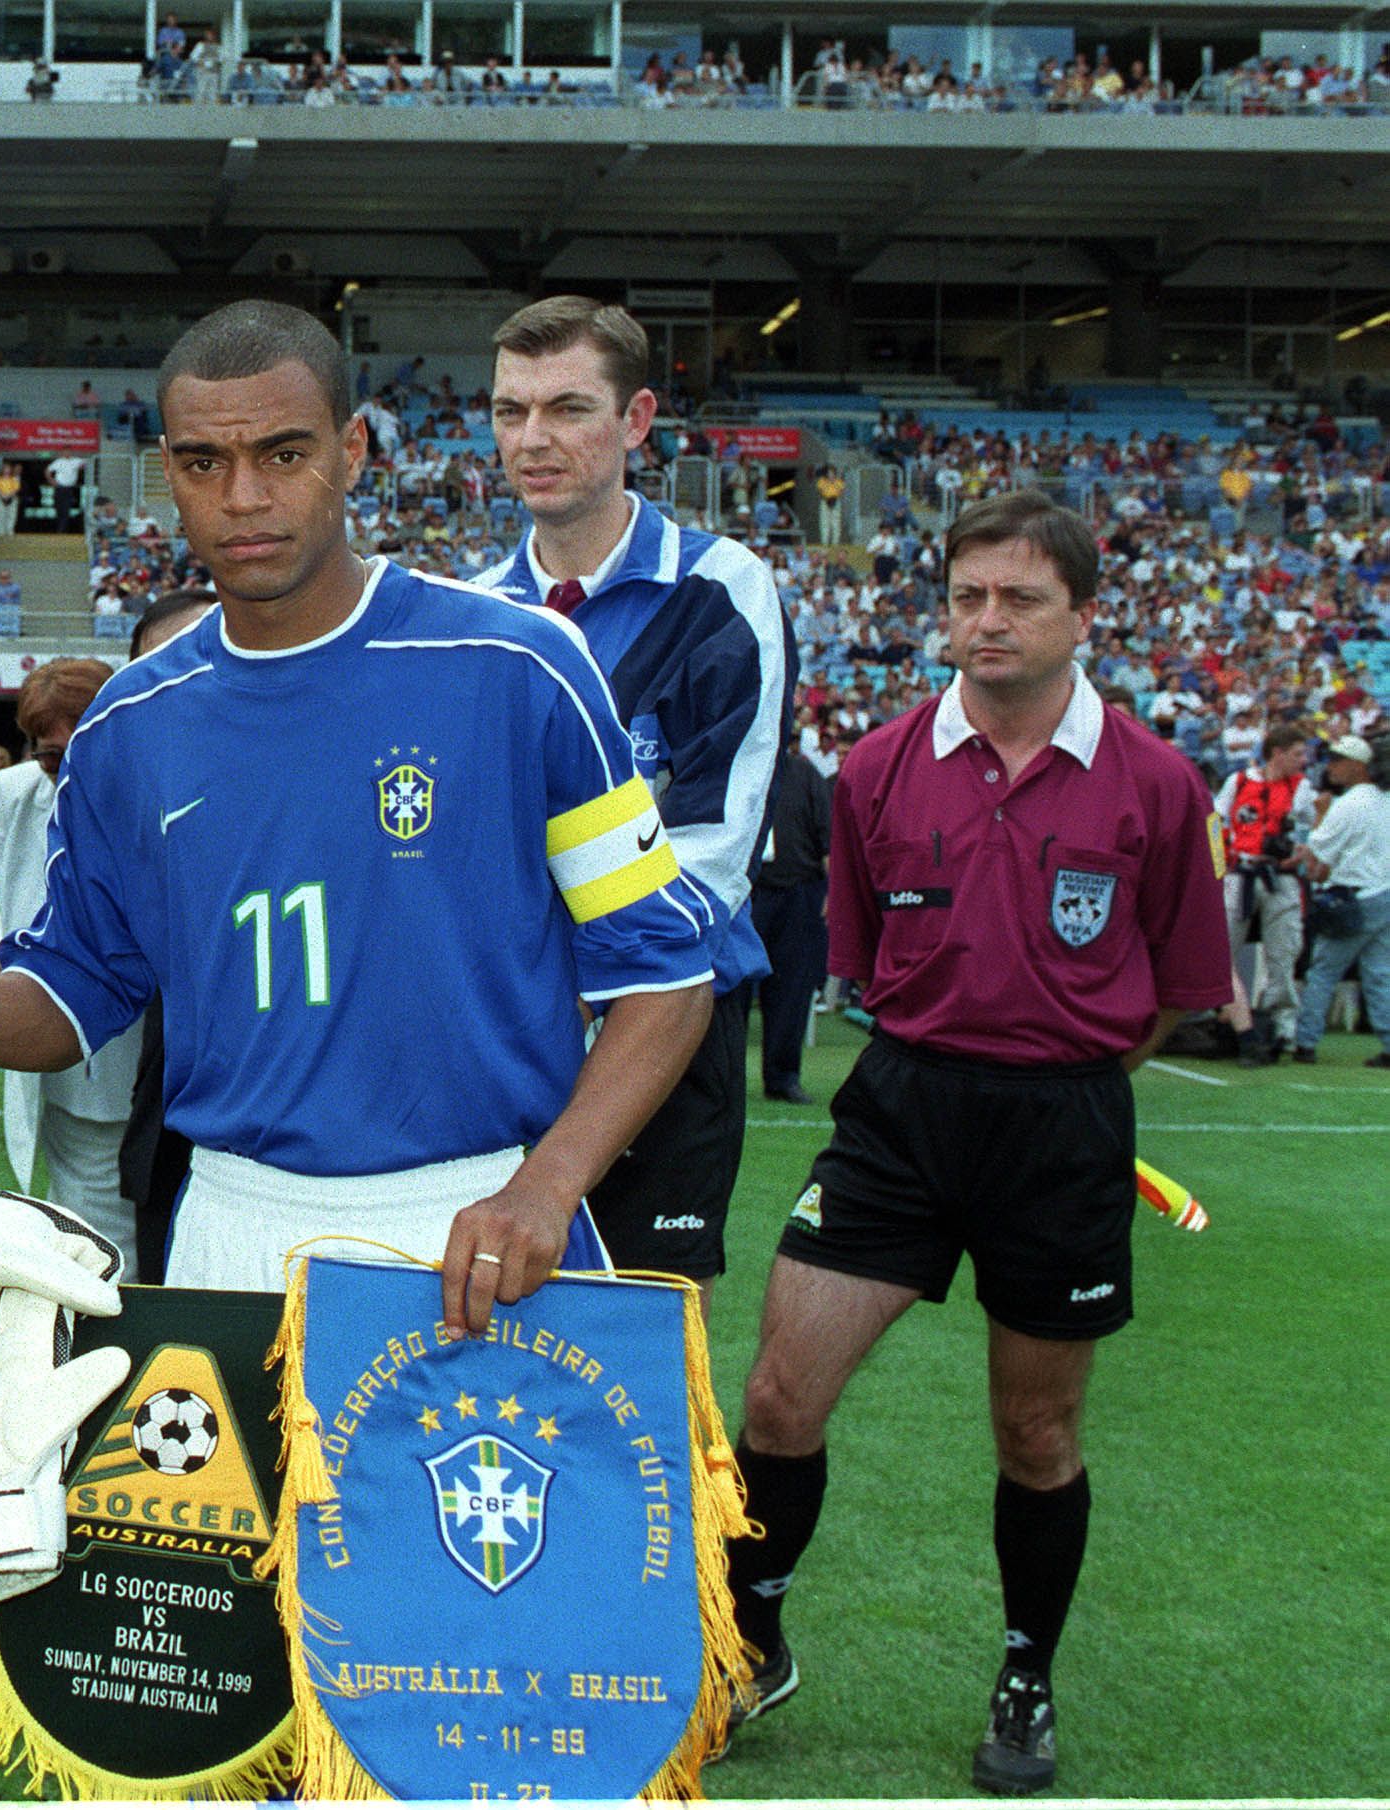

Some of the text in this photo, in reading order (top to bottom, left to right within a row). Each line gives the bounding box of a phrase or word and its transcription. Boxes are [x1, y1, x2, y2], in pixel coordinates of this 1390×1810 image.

[395, 795, 417, 806] CBF
[232, 881, 330, 1012] 11
[1063, 923, 1092, 937] FIFA
[653, 1214, 705, 1230] lotto
[317, 1318, 672, 1584] CONEDERAÇÃO BSILEIRA DE FUTEBOL
[77, 1487, 257, 1534] SOCCER
[469, 1496, 515, 1513] CBF
[71, 1523, 254, 1559] AUSTRALIA
[80, 1571, 234, 1612] LG SOCCEROOS
[142, 1605, 167, 1628] VS
[115, 1626, 187, 1657] BRAZIL
[44, 1648, 253, 1693] SUNDAY, NOVEMBER 14, 1999
[337, 1660, 667, 1702] AUSTRÁLIA X BRASIL
[71, 1676, 219, 1715] STADIUM AUSTRALIA
